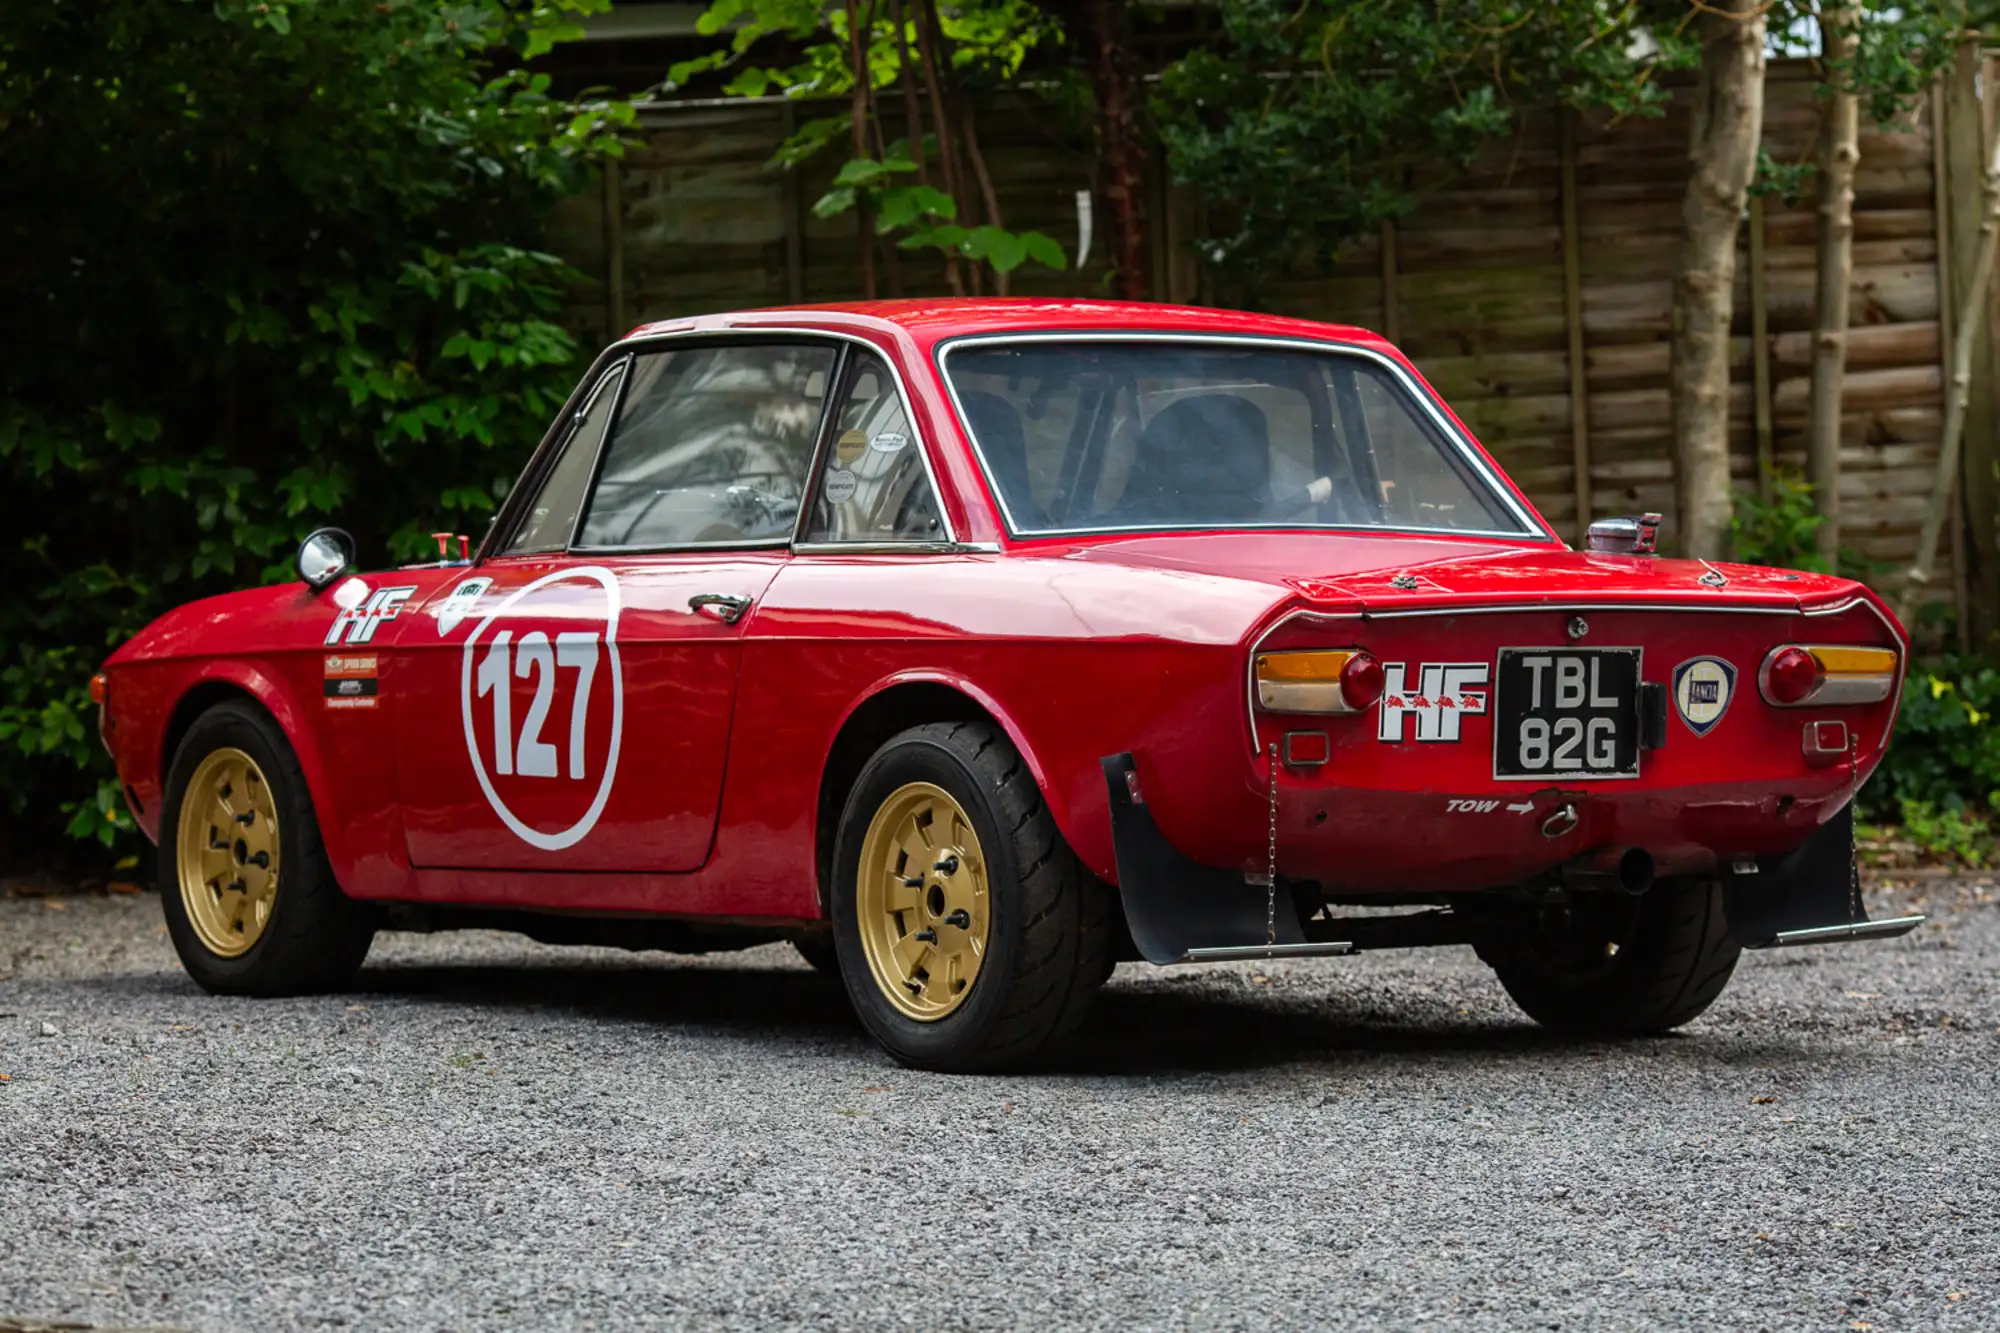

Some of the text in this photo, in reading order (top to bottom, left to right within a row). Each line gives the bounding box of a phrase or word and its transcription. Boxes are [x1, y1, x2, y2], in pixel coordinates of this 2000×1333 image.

[323, 584, 418, 646] HF
[477, 629, 600, 780] 127
[1377, 662, 1490, 745] HF
[1522, 656, 1619, 709] TBL
[1690, 681, 1718, 703] LANCIA
[1519, 717, 1616, 769] 82G
[1445, 799, 1500, 812] TOW
